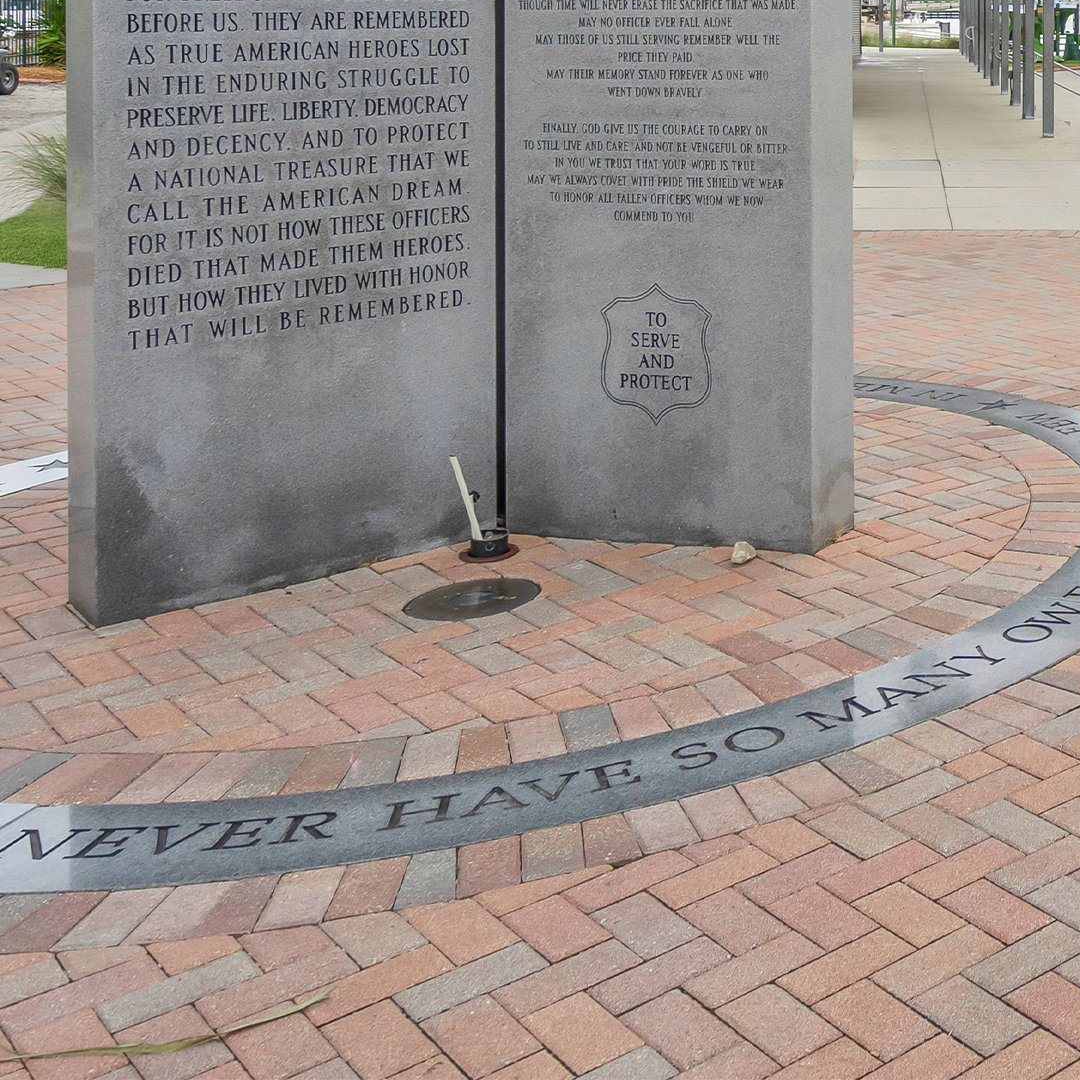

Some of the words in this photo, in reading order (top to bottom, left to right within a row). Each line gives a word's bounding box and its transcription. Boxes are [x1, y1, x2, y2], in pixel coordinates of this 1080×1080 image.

[519, 0, 552, 10] THOUGH
[557, 0, 575, 10] TIME
[580, 0, 597, 10] WILL
[602, 0, 627, 10] NEVER
[631, 0, 656, 10] ERASE
[661, 0, 676, 10] THE
[679, 0, 721, 10] SACRIFICE
[726, 0, 746, 10] THAT
[751, 0, 768, 10] WAS
[128, 13, 204, 32] BEFORE
[212, 13, 244, 31] US.
[252, 12, 301, 31] THEY
[310, 12, 346, 30] ARE
[353, 11, 469, 29] REMEMBERED
[128, 45, 155, 65] AS
[166, 44, 223, 64] TRUE
[233, 41, 339, 62] AMERICAN
[348, 40, 419, 58] HEROES
[428, 39, 469, 56] LOST
[128, 77, 150, 97] IN
[162, 75, 205, 95] THE
[217, 71, 327, 93] ENDURING
[338, 67, 439, 88] STRUGGLE
[449, 66, 470, 84] TO
[128, 105, 224, 128] PRESERVE
[365, 95, 469, 117] DEMOCRACY
[128, 139, 176, 160] AND
[302, 129, 343, 150] AND
[353, 128, 378, 147] TO
[387, 122, 469, 145] PROTECT
[128, 172, 142, 192] A
[154, 164, 264, 190] NATIONAL
[274, 156, 378, 181] TREASURE
[388, 152, 435, 172] THAT
[444, 150, 469, 168] WE
[128, 200, 189, 223] CALL
[203, 195, 249, 217] THE
[262, 185, 380, 212] AMERICAN
[392, 178, 471, 202] DREAM.
[128, 233, 167, 255] FOR
[177, 229, 195, 251] IT
[206, 228, 223, 248] IS
[231, 224, 270, 245] NOT
[278, 218, 322, 241] HOW
[330, 213, 386, 236] THESE
[391, 206, 469, 230] OFFICERS
[128, 263, 182, 287] DIED
[193, 256, 249, 280] THAT
[260, 249, 319, 273] MADE
[329, 242, 384, 265] THEM
[393, 233, 471, 258] HEROES.
[128, 296, 169, 319] BUT
[178, 288, 226, 313] HOW
[234, 282, 285, 306] THEY
[294, 275, 347, 299] LIVED
[355, 269, 402, 292] WITH
[409, 261, 469, 285] HONOR
[128, 322, 194, 350] THAT
[209, 313, 267, 340] WILL
[280, 309, 306, 330] BE
[319, 289, 471, 325] REMEMBERED.
[645, 312, 667, 327] TO
[631, 332, 680, 349] SERVE
[638, 354, 674, 369] AND
[620, 373, 692, 391] PROTECT
[911, 389, 968, 402] IN
[0, 811, 339, 862] NEVER
[376, 758, 643, 832] HAVE
[669, 726, 786, 771] SO
[796, 645, 1006, 732] MANY
